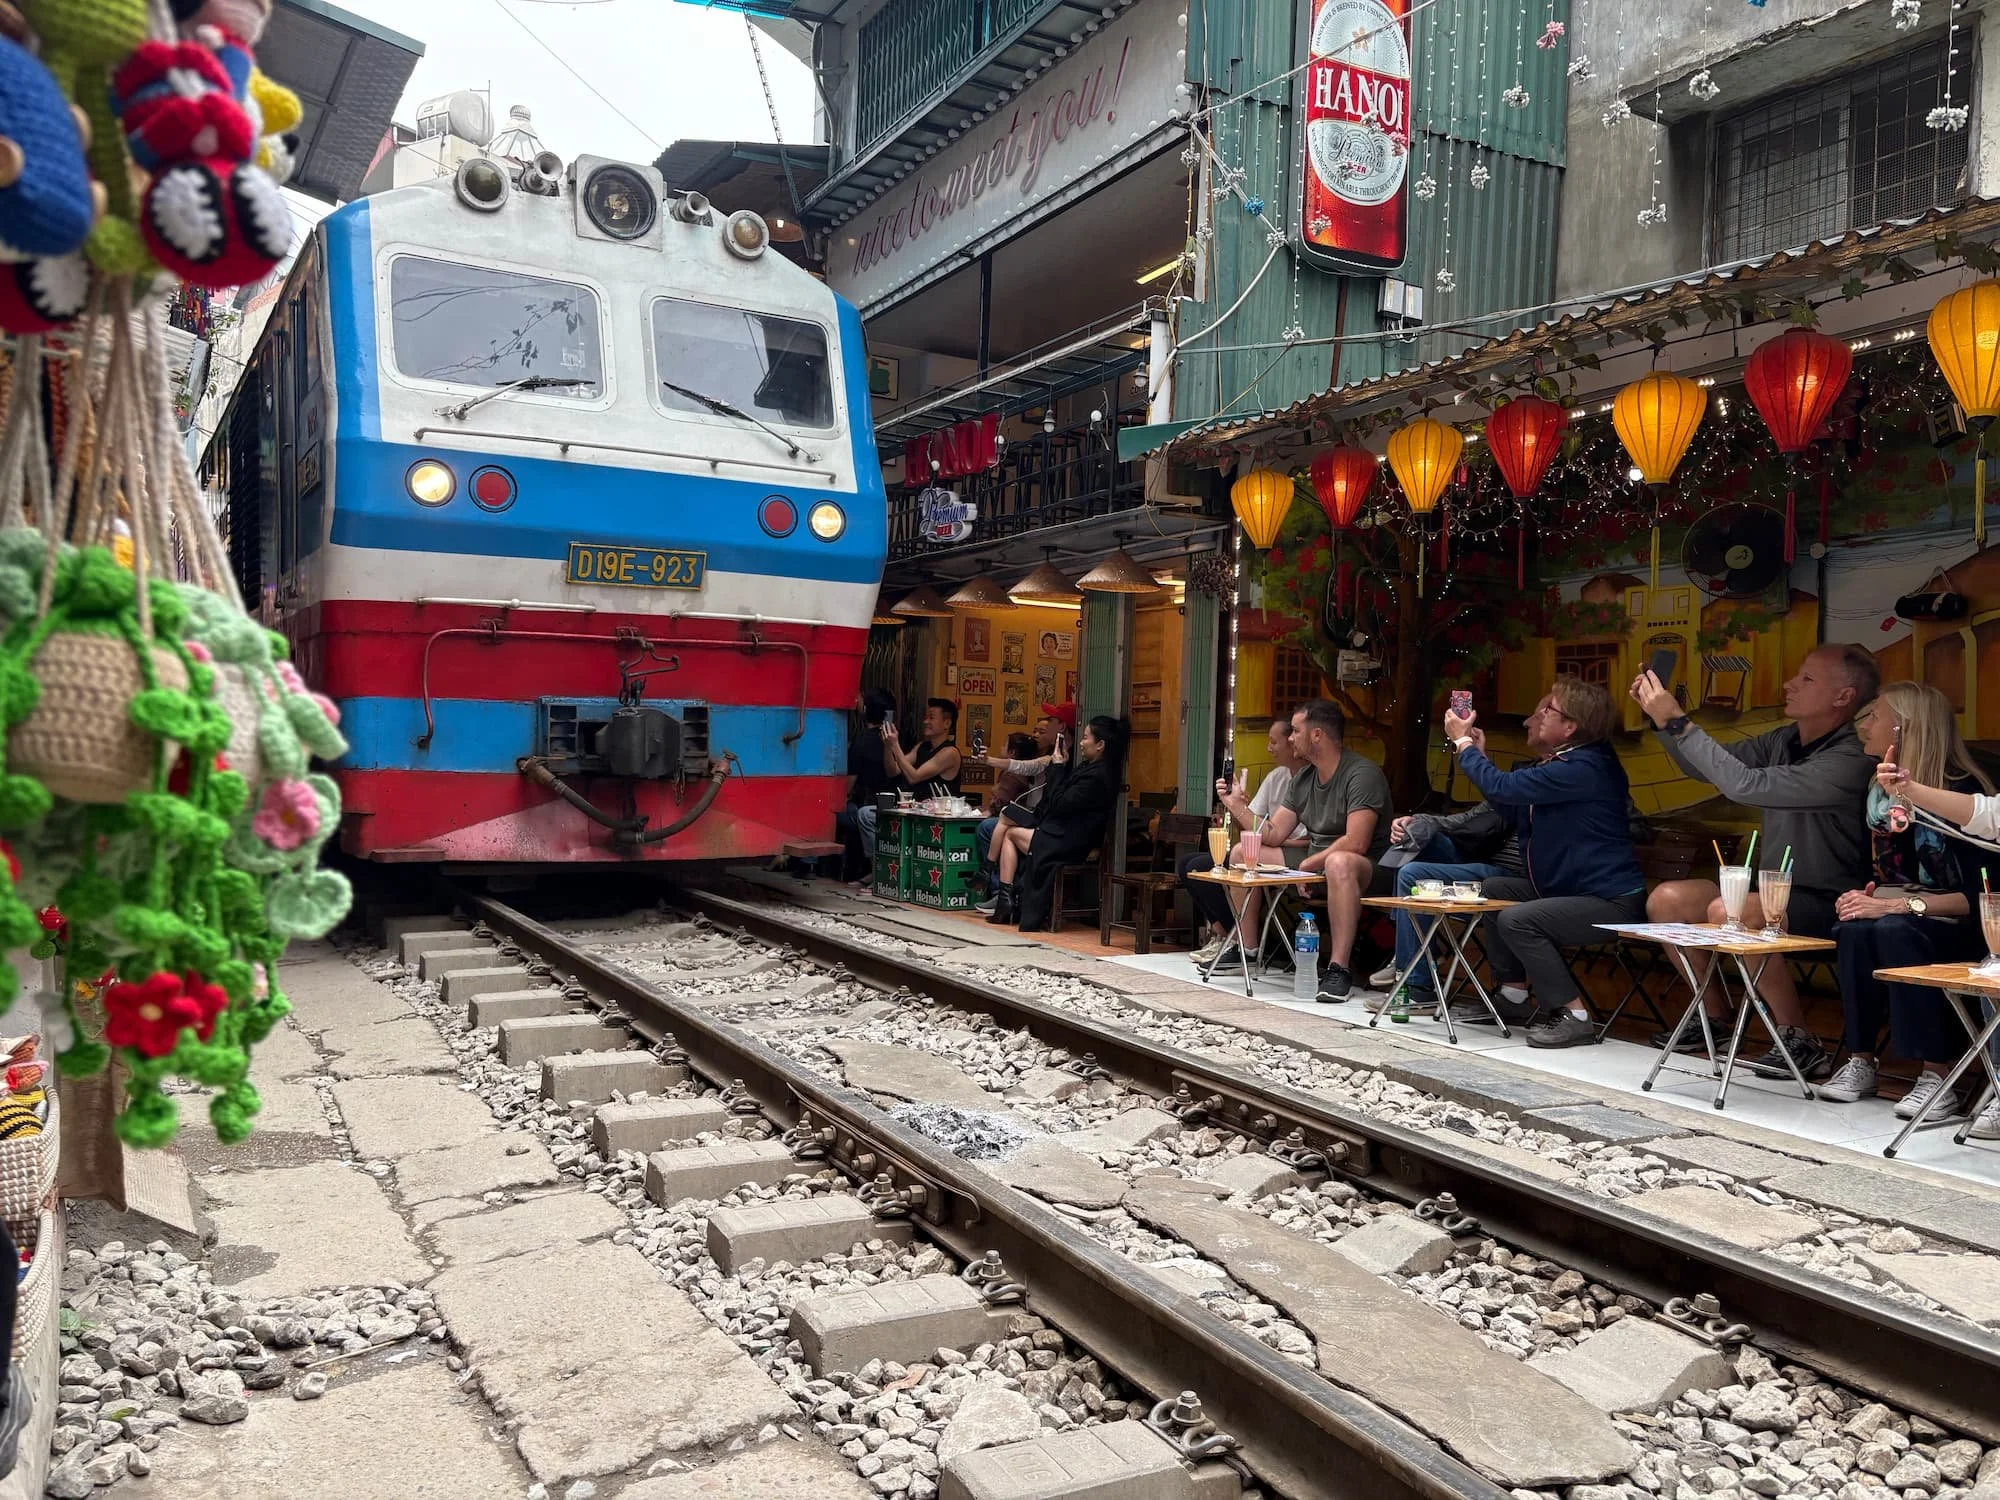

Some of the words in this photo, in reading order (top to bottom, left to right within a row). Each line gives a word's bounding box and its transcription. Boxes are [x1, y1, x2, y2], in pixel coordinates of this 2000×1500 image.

[1336, 2, 1358, 13] BREWED
[1360, 2, 1366, 11] BY
[1366, 5, 1384, 21] USING
[1314, 67, 1404, 131] HANOI
[854, 207, 907, 277] nice
[909, 175, 939, 241] to
[939, 106, 1023, 220] meet
[1020, 36, 1132, 194] you!
[1359, 179, 1392, 196] THROUGHOUT
[904, 412, 998, 488] HNOI
[577, 550, 697, 584] D19E-923
[963, 679, 994, 693] OPEN
